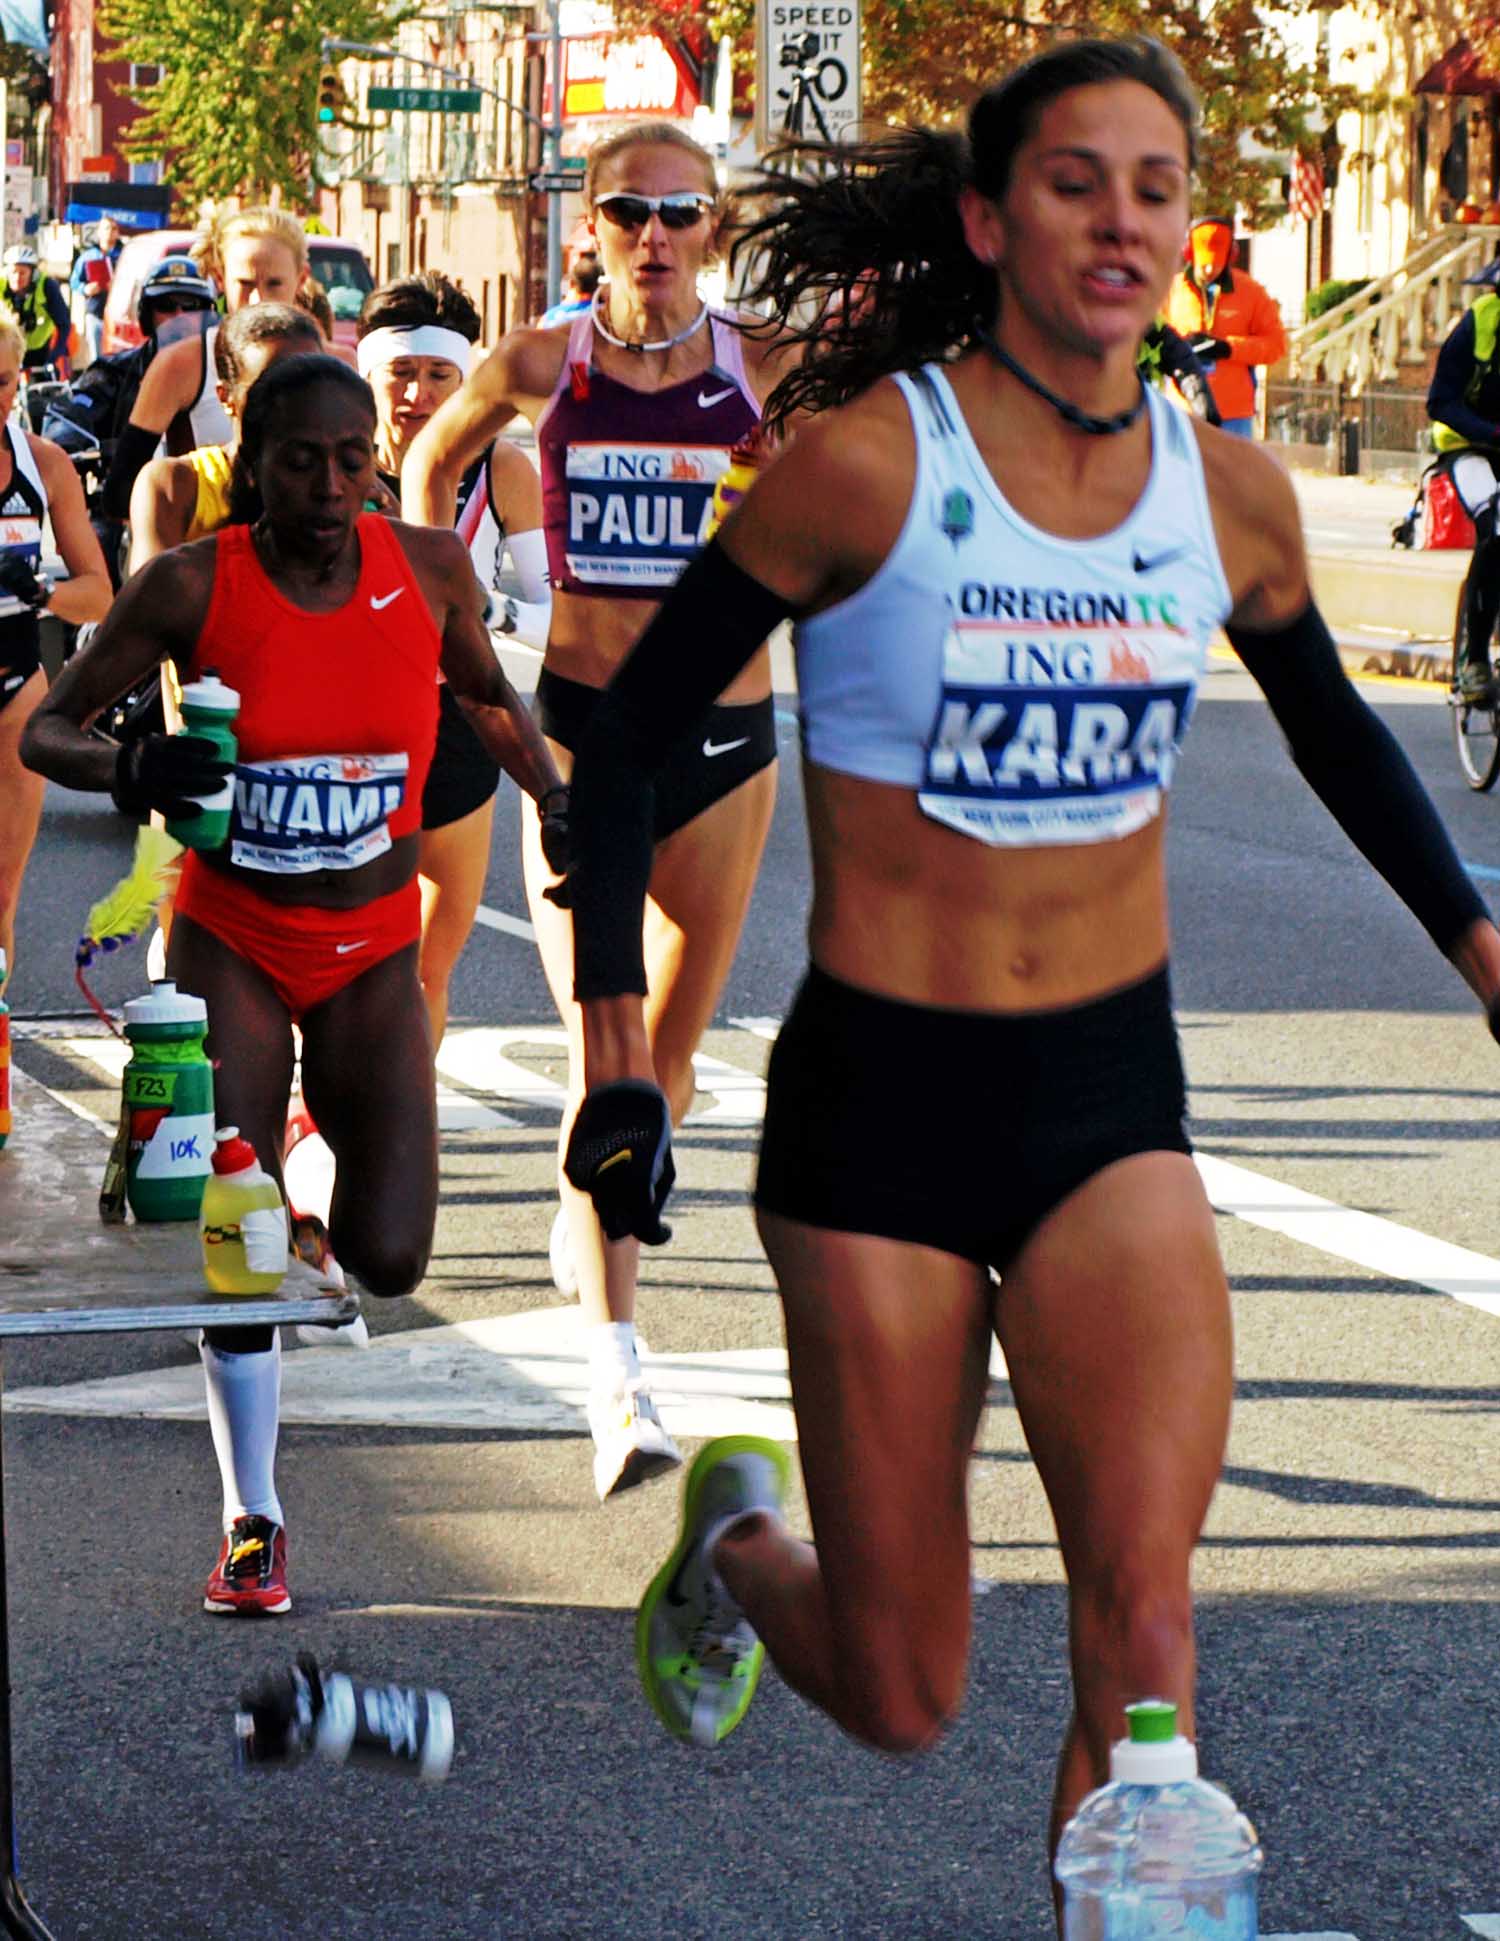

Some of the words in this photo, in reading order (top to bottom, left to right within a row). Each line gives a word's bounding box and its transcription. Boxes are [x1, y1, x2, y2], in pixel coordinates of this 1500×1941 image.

[773, 7, 853, 26] SPEED
[604, 453, 661, 479] ING
[1005, 642, 1093, 687] ING
[929, 700, 1177, 789] KARA
[136, 1076, 167, 1097] F23
[170, 1134, 202, 1162] 10K
